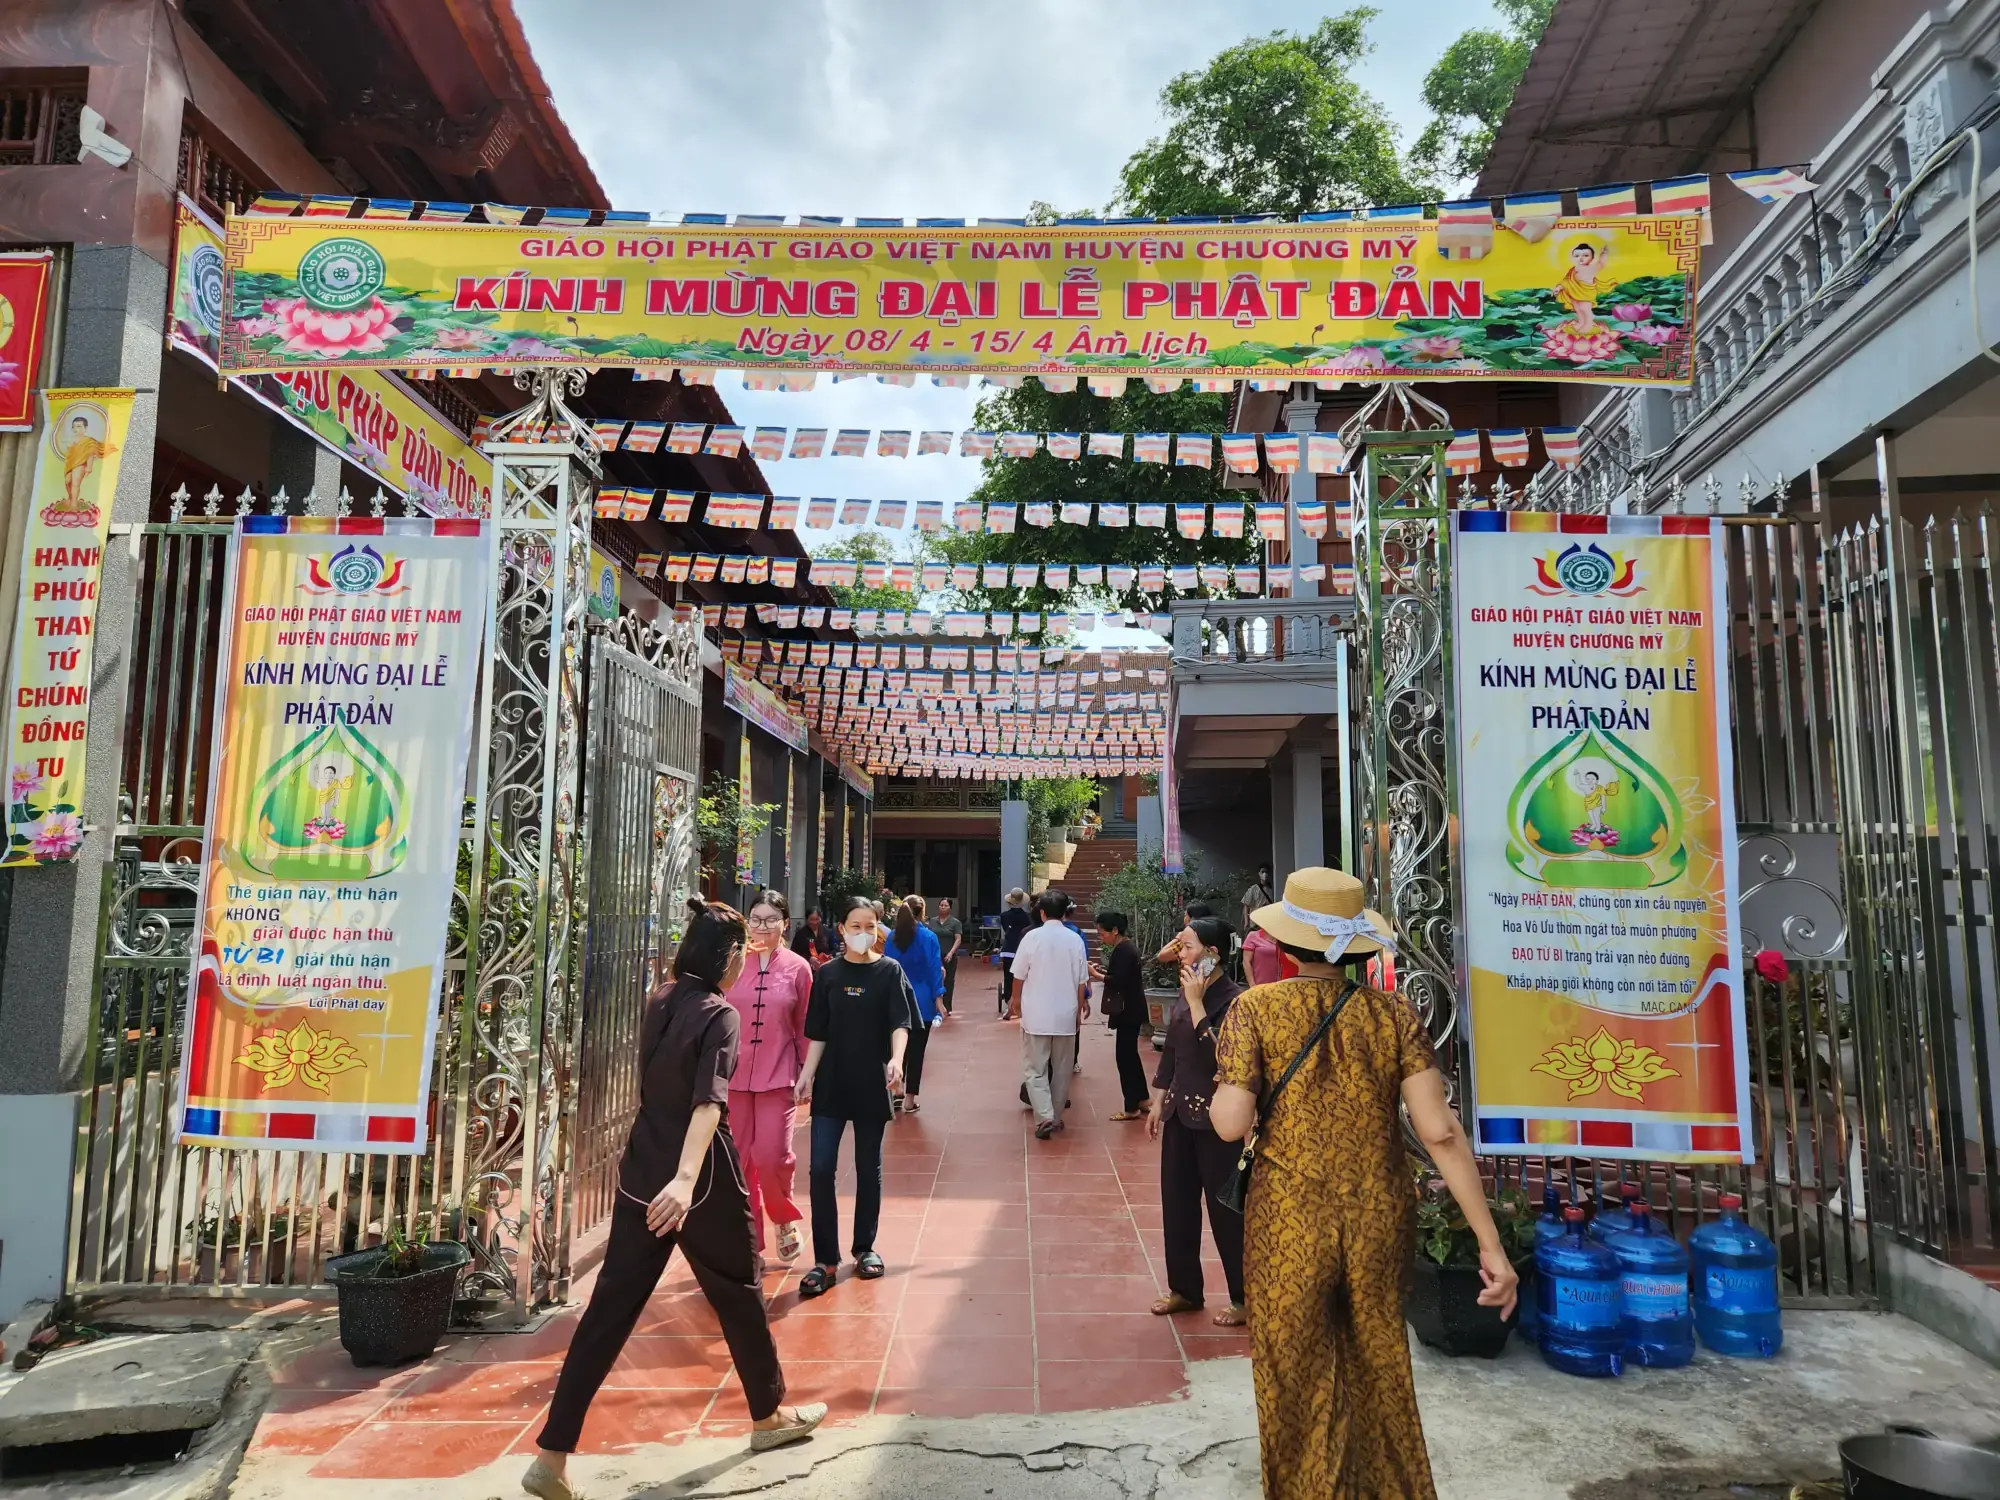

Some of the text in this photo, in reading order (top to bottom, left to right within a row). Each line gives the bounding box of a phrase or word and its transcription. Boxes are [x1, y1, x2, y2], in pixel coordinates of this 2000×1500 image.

[520, 234, 1418, 266] GIÁO HỘI PHẬT GIÁO VIỆT NAM HUYỆN CHƯƠNG MỸ
[338, 289, 362, 302] NAM
[453, 265, 1484, 328] KÍNH MỪNG ĐẠI LỄ PHẬT ĐẢN
[737, 327, 833, 359] Ngày
[845, 328, 903, 354] 08/
[910, 329, 930, 353] 4
[968, 328, 1024, 354] 15/
[1032, 330, 1053, 354] 4
[1067, 327, 1136, 355] Âm
[1140, 330, 1208, 360] lịch
[337, 373, 398, 457] PHÁP
[401, 425, 442, 494] DÂN
[34, 614, 93, 637] THAY
[244, 604, 462, 626] GIÁO HỘI PHẬT GIÁO VIỆT NAM
[1471, 605, 1702, 628] GIÁO HỘI PHẬT GIÁO VIỆT NAM
[278, 629, 419, 648] HUYỆN CHƯƠNG MỸ
[1513, 630, 1664, 651] HUYỆN CHƯƠNG MỸ
[48, 648, 81, 672] TỨ
[243, 654, 448, 692] KÍNH MỪNG ĐẠI LỄ
[1480, 658, 1698, 695] KÍNH MỪNG ĐẠI LỄ
[17, 682, 89, 708] CHÚN
[284, 695, 393, 730] PHẬT ĐẢN
[1532, 700, 1650, 735] PHẬT ĐẢN
[22, 714, 86, 744] ĐỒNG
[36, 757, 65, 778] TU
[228, 884, 253, 899] Thế
[257, 886, 292, 902] gian
[337, 887, 362, 901] thù
[368, 887, 398, 904] hận
[1521, 890, 1548, 909] PHẬT
[1579, 894, 1610, 911] chúng
[1614, 898, 1631, 909] con
[1634, 896, 1650, 909] xin
[1653, 895, 1671, 910] cầu
[1674, 898, 1707, 914] nguyện
[226, 904, 280, 921] KHÔNG
[253, 924, 393, 943] giải được hận thù
[1502, 919, 1697, 940] Hoa Vô Ưu thơm ngát toả muôn phương
[223, 942, 390, 970] TỪ BI giải thù hận
[1512, 944, 1690, 968] ĐẠO TỪ BI trang trải vạn nẻo đường
[218, 972, 231, 986] Là
[237, 973, 270, 989] định
[277, 973, 306, 990] luật
[312, 974, 351, 991] ngàn
[1507, 972, 1532, 990] Khắp
[1535, 975, 1559, 991] pháp
[1562, 976, 1579, 992] giới
[1583, 976, 1614, 993] không
[1617, 977, 1635, 991] còn
[1639, 980, 1655, 992] nơi
[331, 998, 359, 1011] Phật
[363, 999, 385, 1012] dạy
[1641, 1001, 1665, 1014] MẠC
[1569, 1286, 1602, 1304] AQUA
